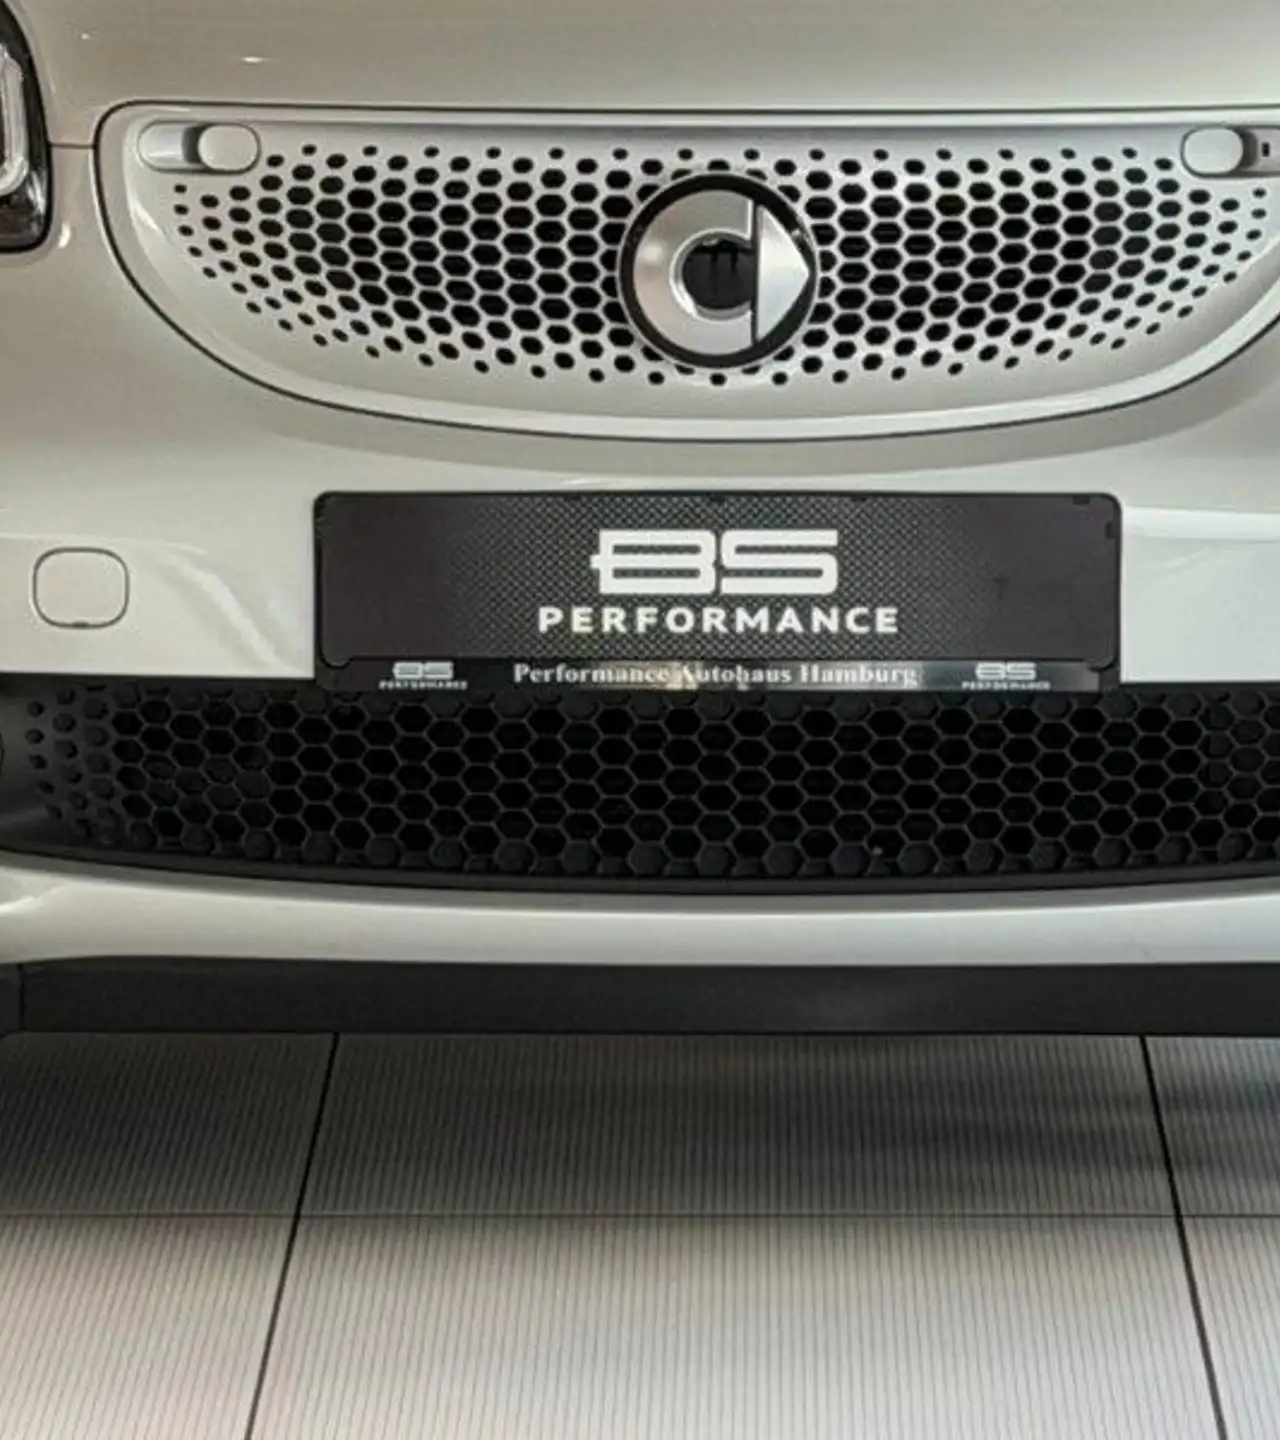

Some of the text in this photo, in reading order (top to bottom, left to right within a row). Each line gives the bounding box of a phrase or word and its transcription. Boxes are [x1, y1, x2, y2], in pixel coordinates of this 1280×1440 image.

[590, 529, 838, 594] BS
[538, 607, 899, 633] PERFORMANCE
[513, 663, 919, 688] Performance Autohaus Hamburg
